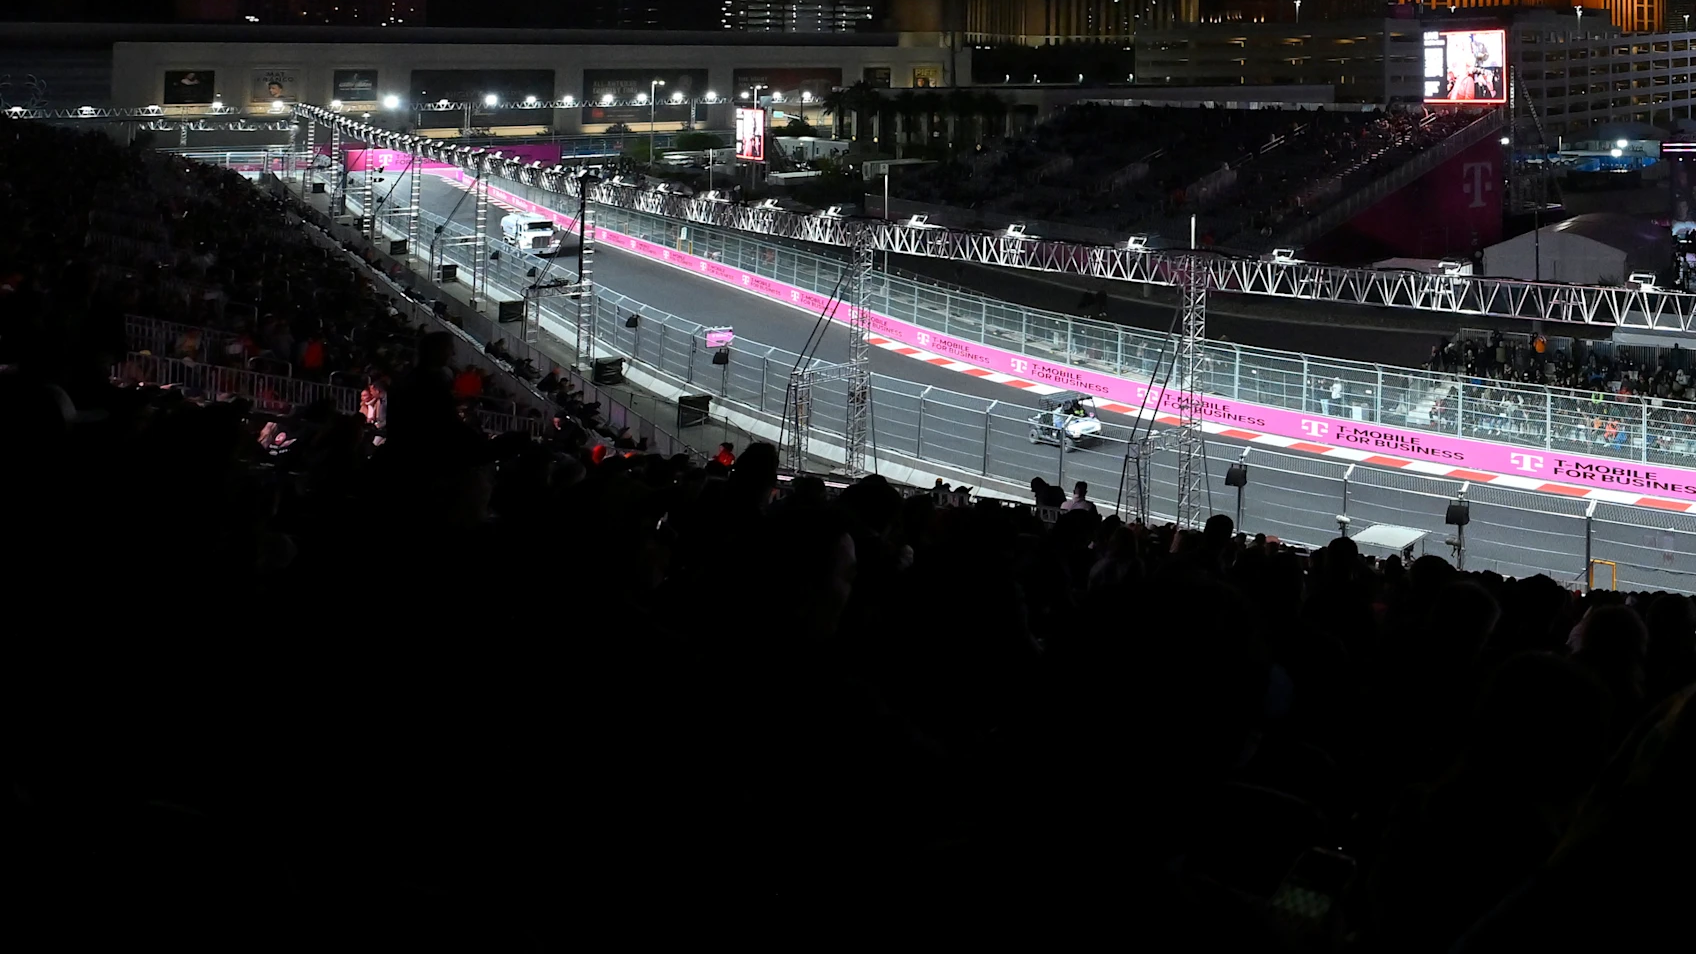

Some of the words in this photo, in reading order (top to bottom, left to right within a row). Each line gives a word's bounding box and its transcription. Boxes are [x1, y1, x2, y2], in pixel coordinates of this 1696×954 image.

[931, 342, 948, 352] FOR
[949, 347, 990, 364] BUSINESS
[933, 336, 970, 353] T-MOBILE
[1031, 369, 1052, 382] FOR
[1054, 374, 1109, 394] BUSINESS
[1032, 363, 1082, 381] T-MOBILE
[1336, 425, 1420, 446] T-MOBILE
[1336, 433, 1370, 445] FOR
[1374, 438, 1465, 461] BUSINESS
[1554, 459, 1657, 481] T-MOBILE
[1554, 468, 1596, 480] FOR
